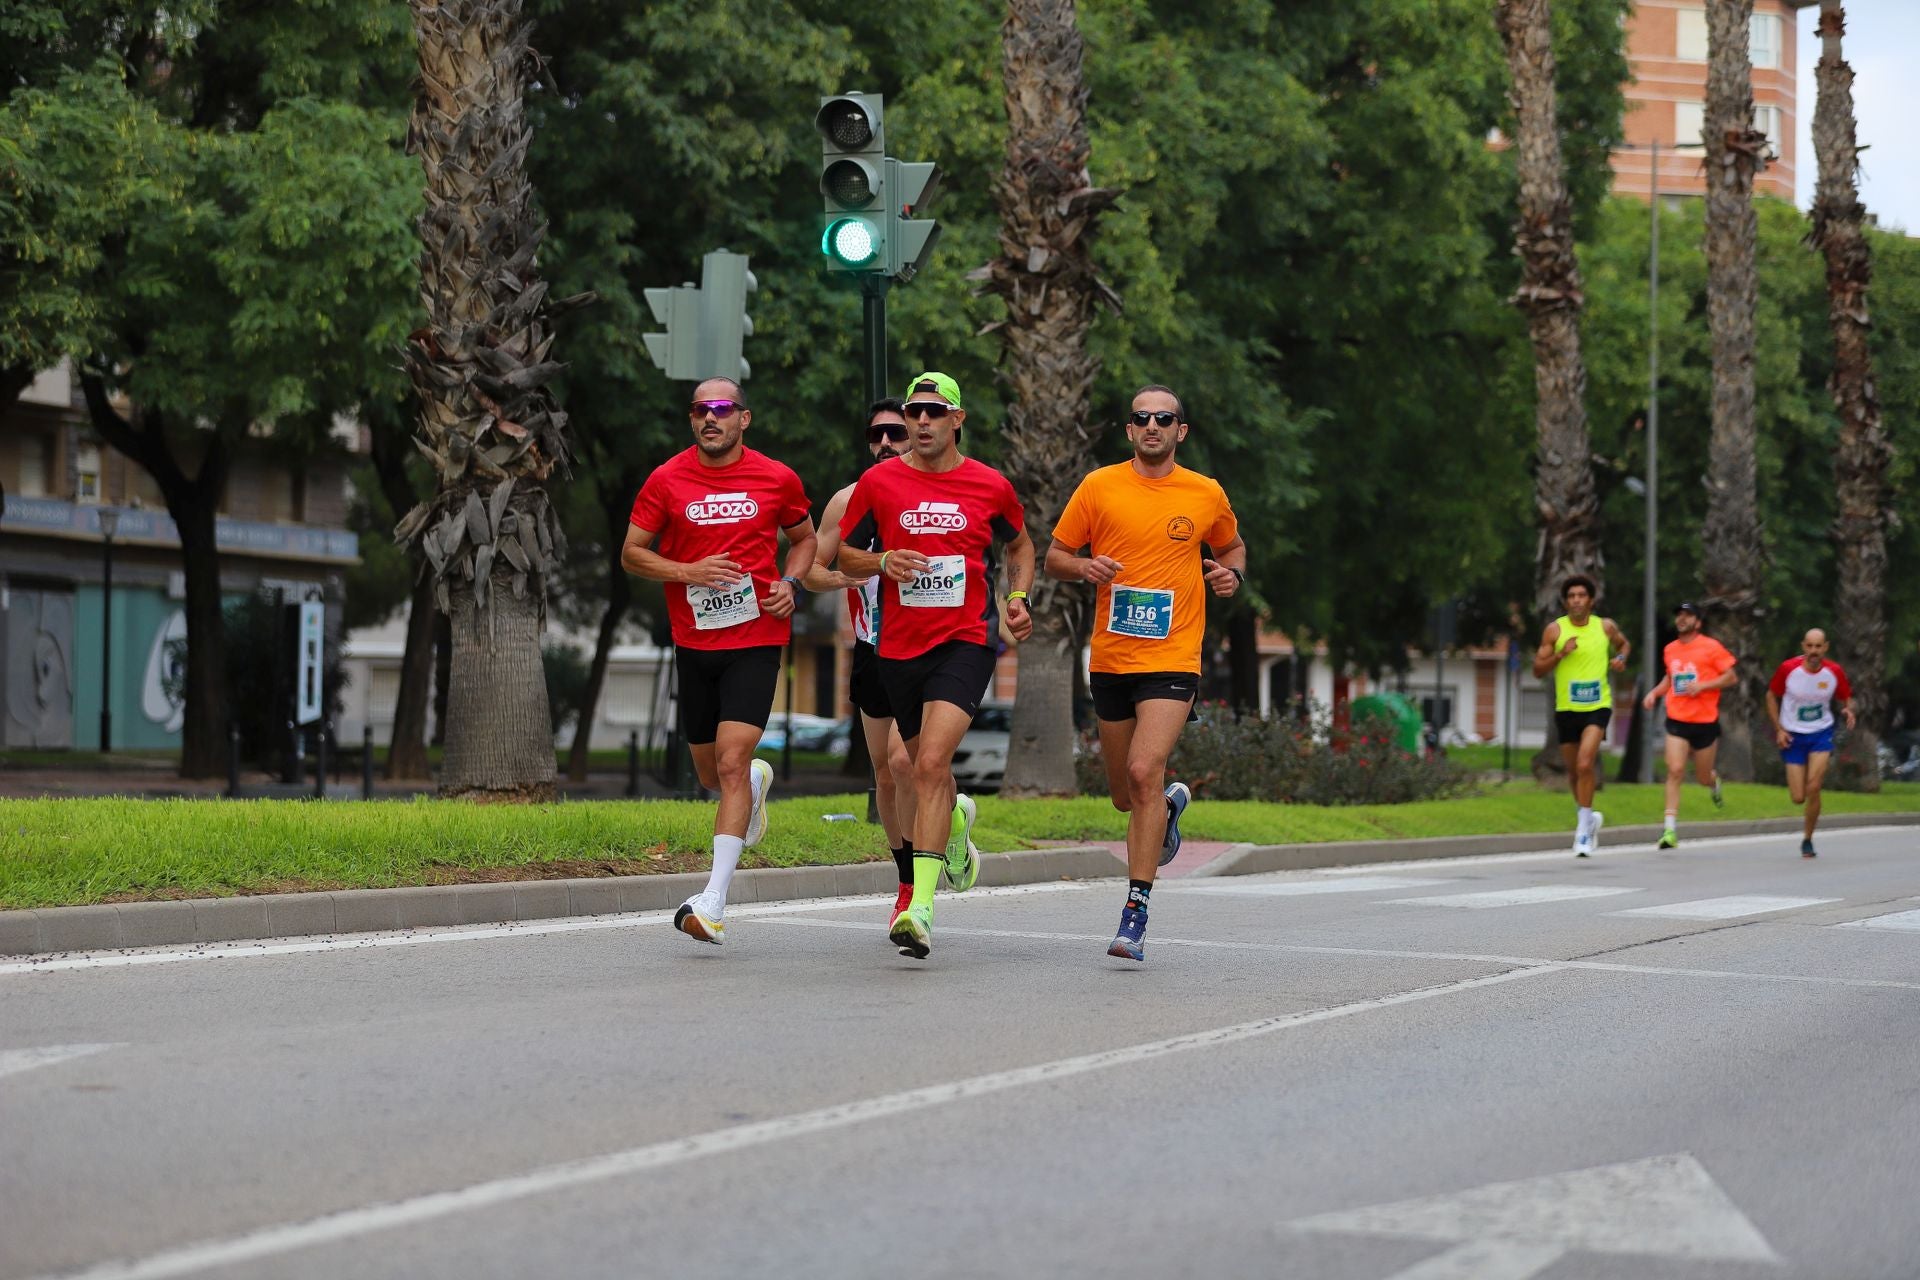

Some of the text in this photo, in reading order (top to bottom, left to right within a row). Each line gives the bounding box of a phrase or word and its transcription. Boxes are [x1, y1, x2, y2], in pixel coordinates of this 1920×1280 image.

[912, 575, 954, 590] 2056
[702, 592, 743, 611] 2055
[1127, 605, 1157, 621] 156
